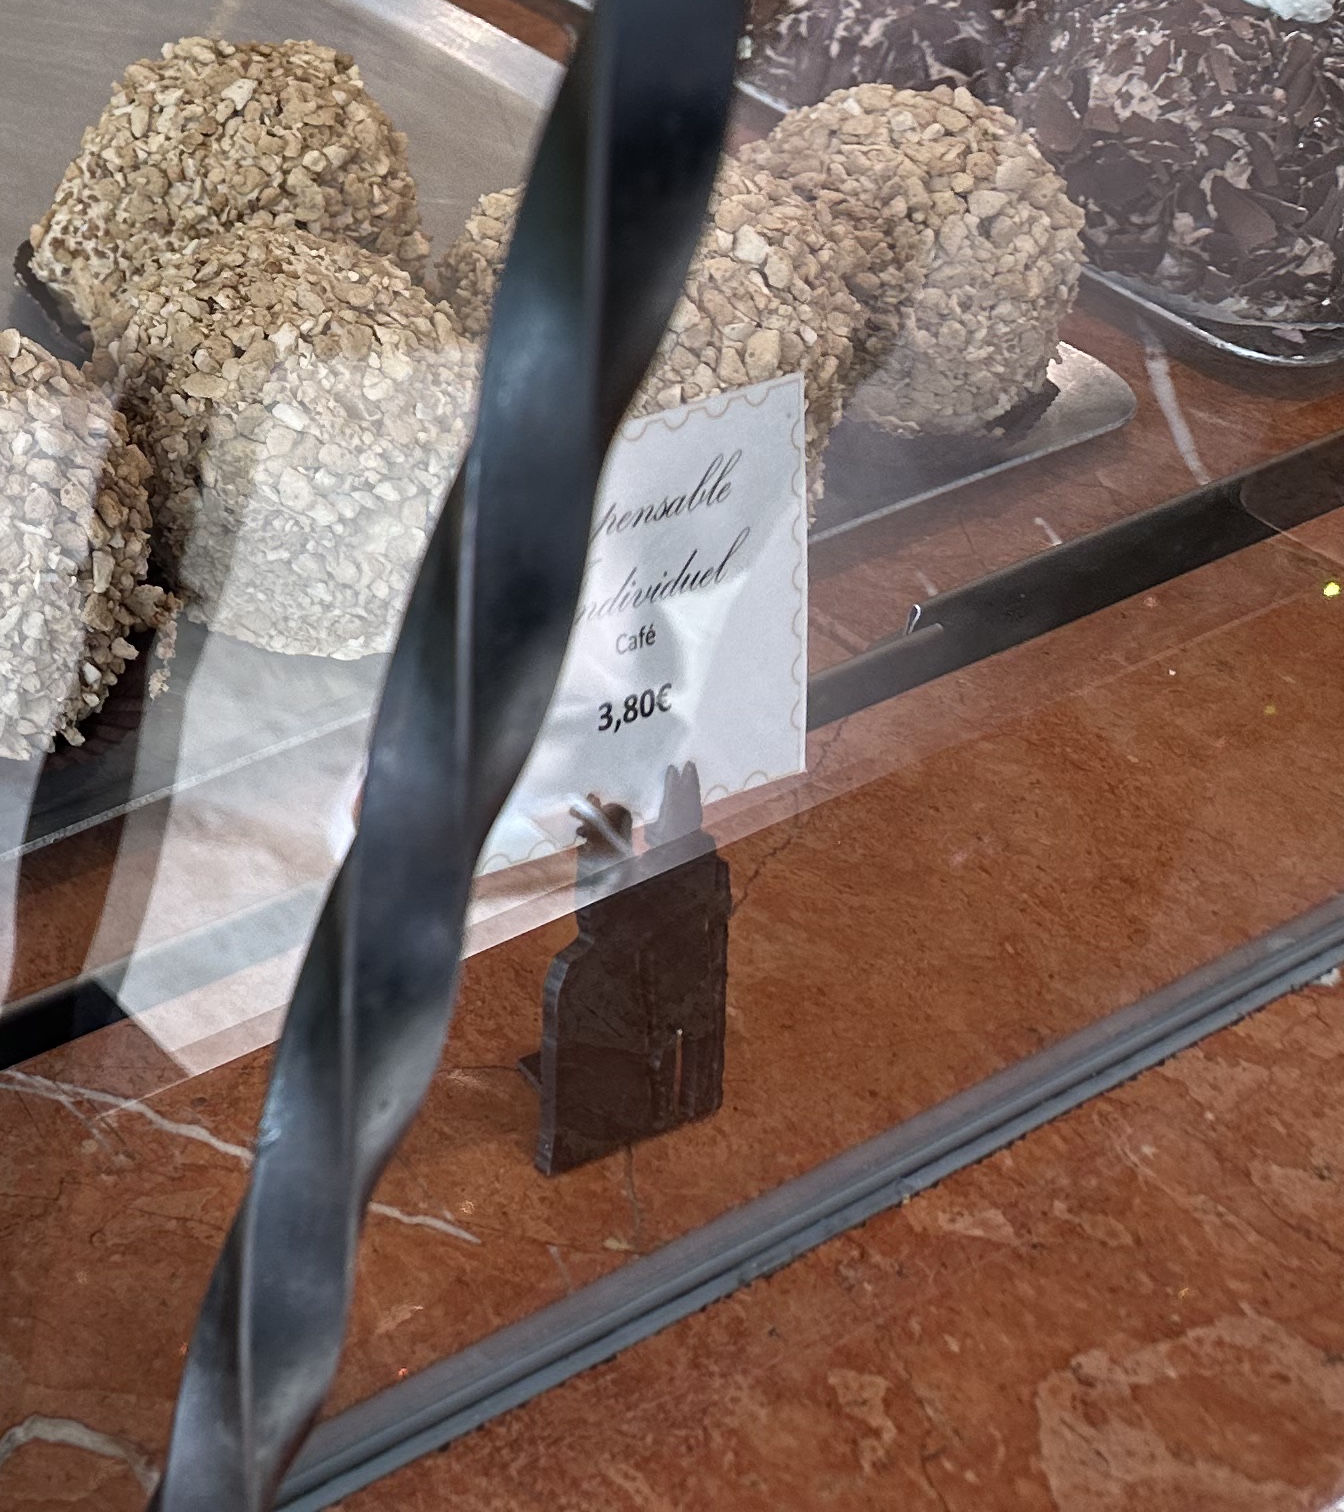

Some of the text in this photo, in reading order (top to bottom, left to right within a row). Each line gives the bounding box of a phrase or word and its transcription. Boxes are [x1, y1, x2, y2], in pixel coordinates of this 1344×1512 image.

[589, 448, 743, 538] pensable
[576, 527, 751, 622] ndividuel
[615, 623, 656, 655] Café
[597, 682, 672, 733] 3,80€
